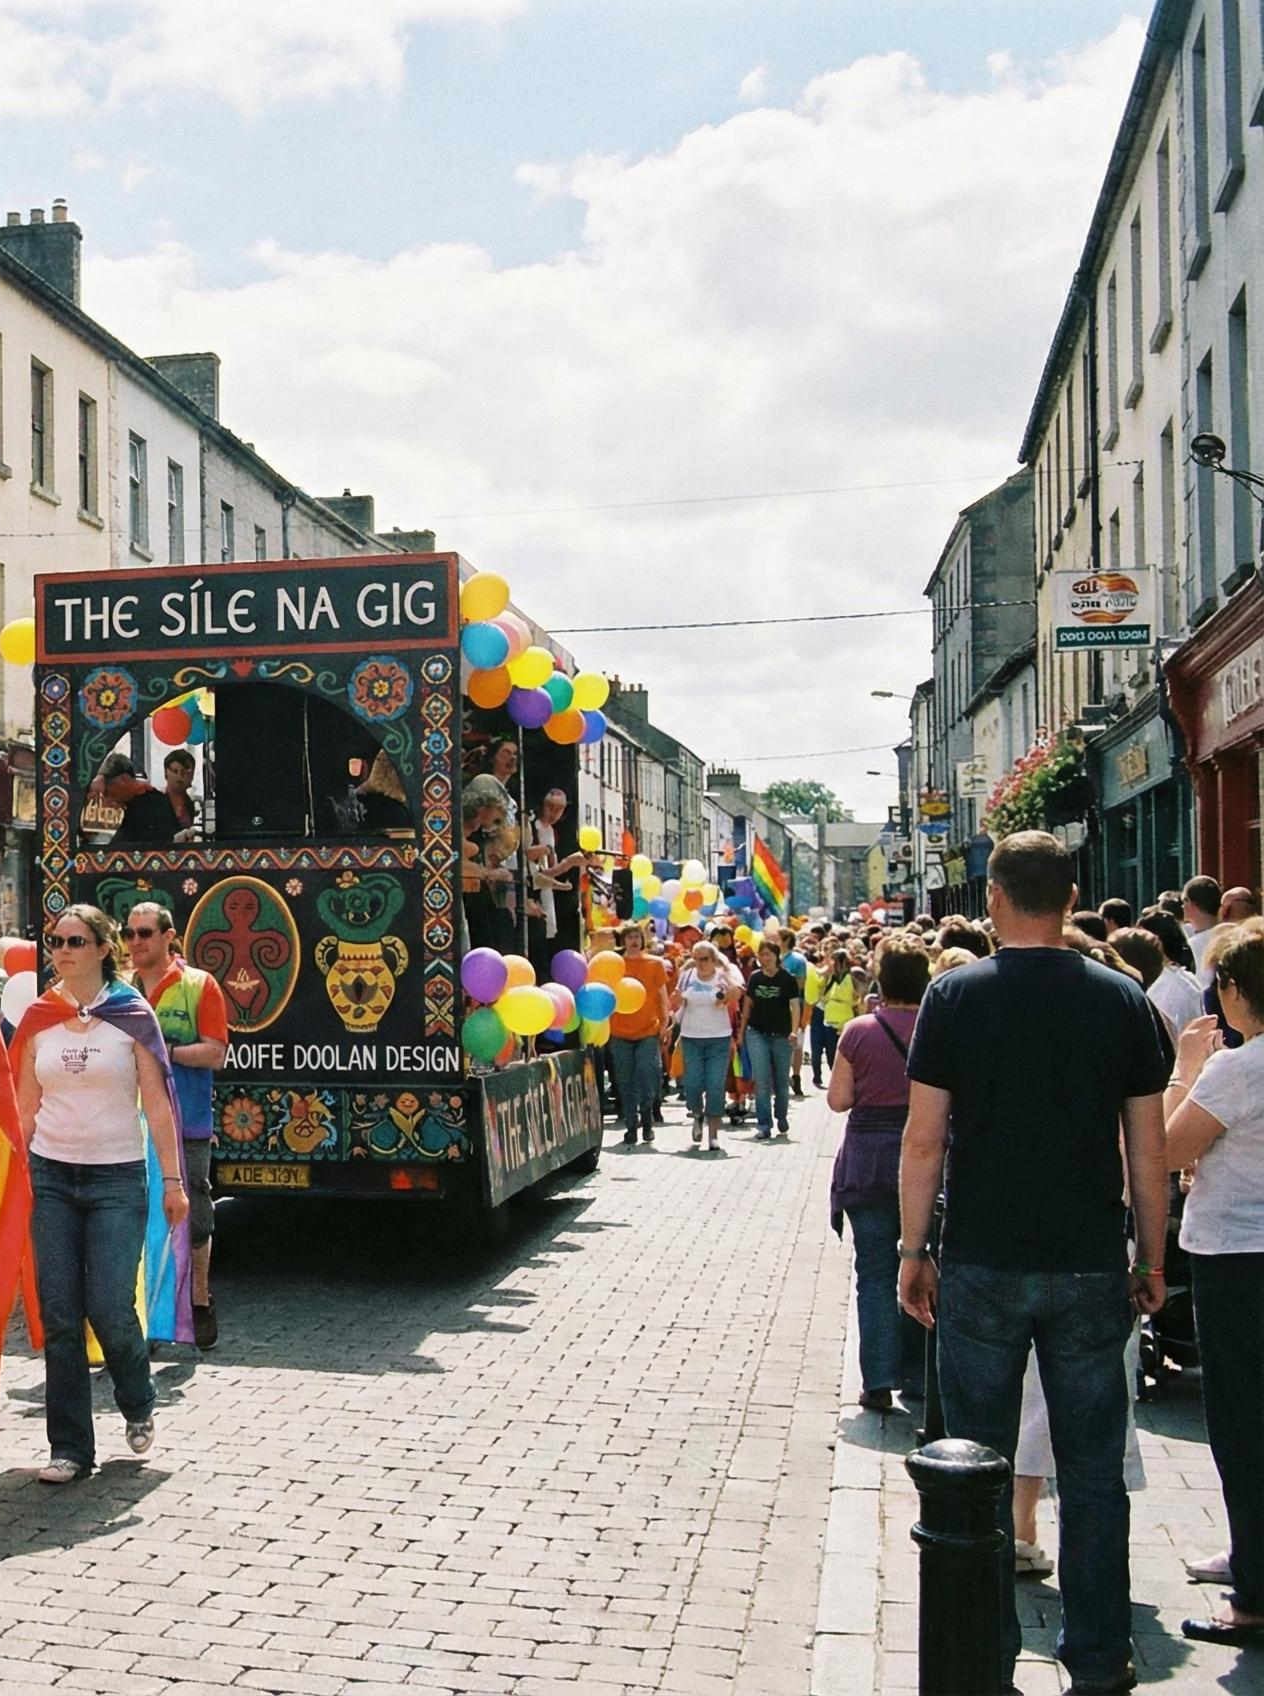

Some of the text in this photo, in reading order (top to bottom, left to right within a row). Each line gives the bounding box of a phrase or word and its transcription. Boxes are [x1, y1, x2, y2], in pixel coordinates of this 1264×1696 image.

[54, 577, 436, 641] THE SÍLE NA GIG
[223, 1043, 460, 1072] AOIFE DOOLAN DESIGN
